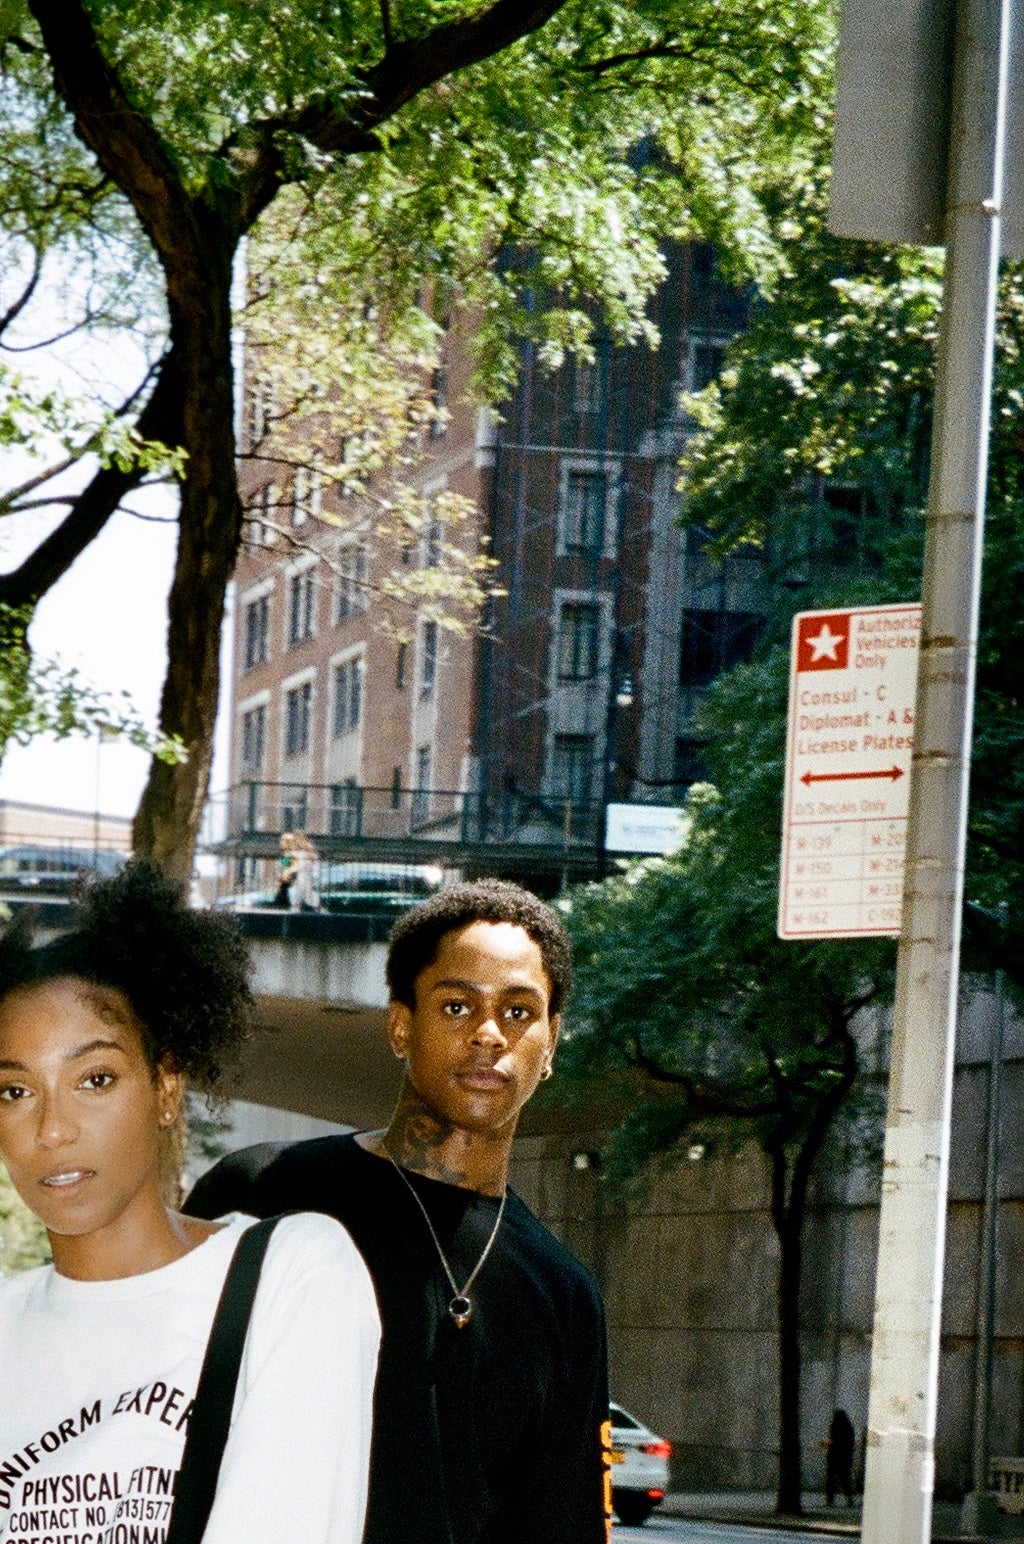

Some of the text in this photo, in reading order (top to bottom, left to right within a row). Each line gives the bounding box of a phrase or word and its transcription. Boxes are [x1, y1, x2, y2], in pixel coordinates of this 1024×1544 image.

[797, 738, 858, 755] License
[21, 1471, 123, 1507] PHYSICAL
[9, 1508, 79, 1533] CONTACT
[85, 1505, 110, 1527] NO.
